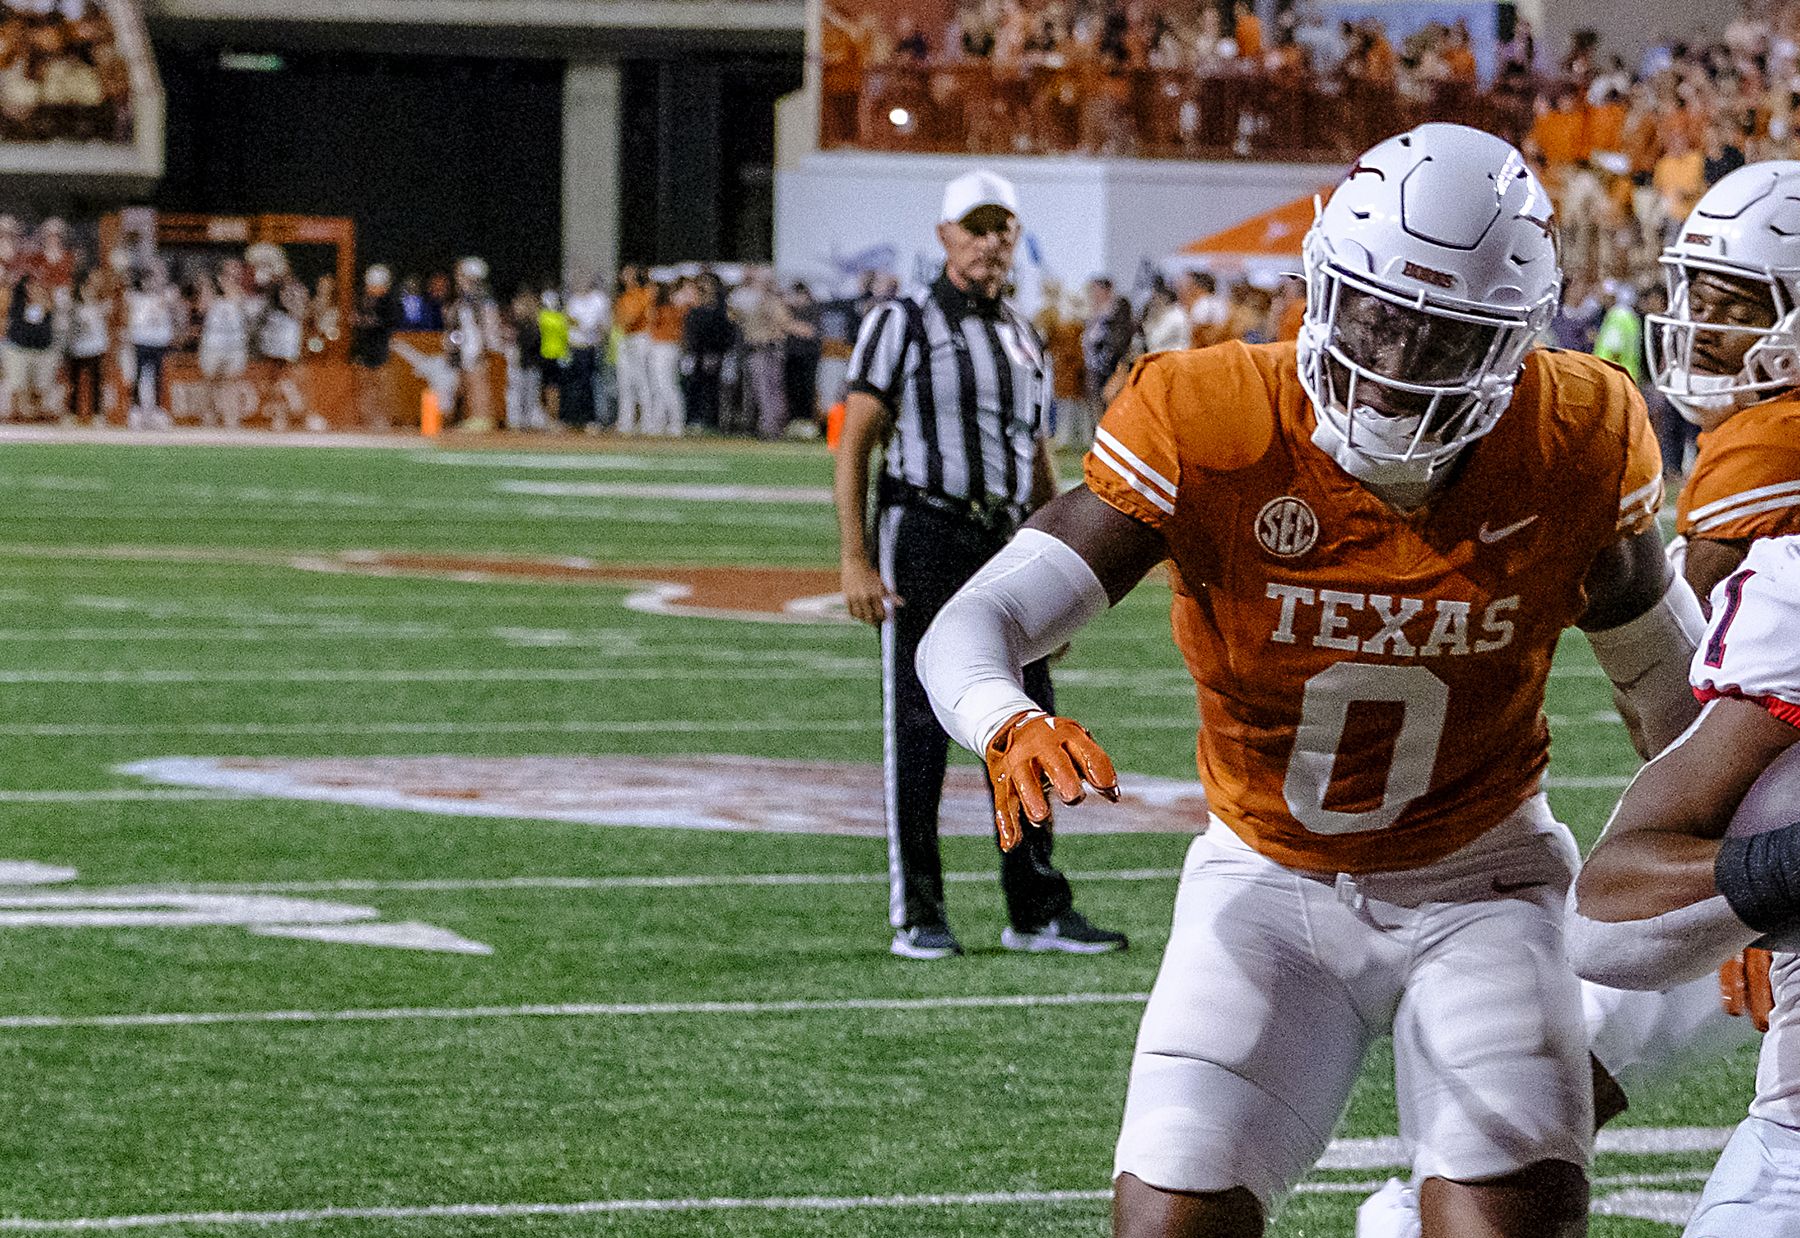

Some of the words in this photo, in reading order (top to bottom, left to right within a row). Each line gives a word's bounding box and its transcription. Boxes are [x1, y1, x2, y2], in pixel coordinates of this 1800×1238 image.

[1257, 499, 1313, 555] SEC
[1264, 581, 1521, 657] TEXAS
[1703, 568, 1758, 670] 1
[1282, 661, 1450, 836] 0
